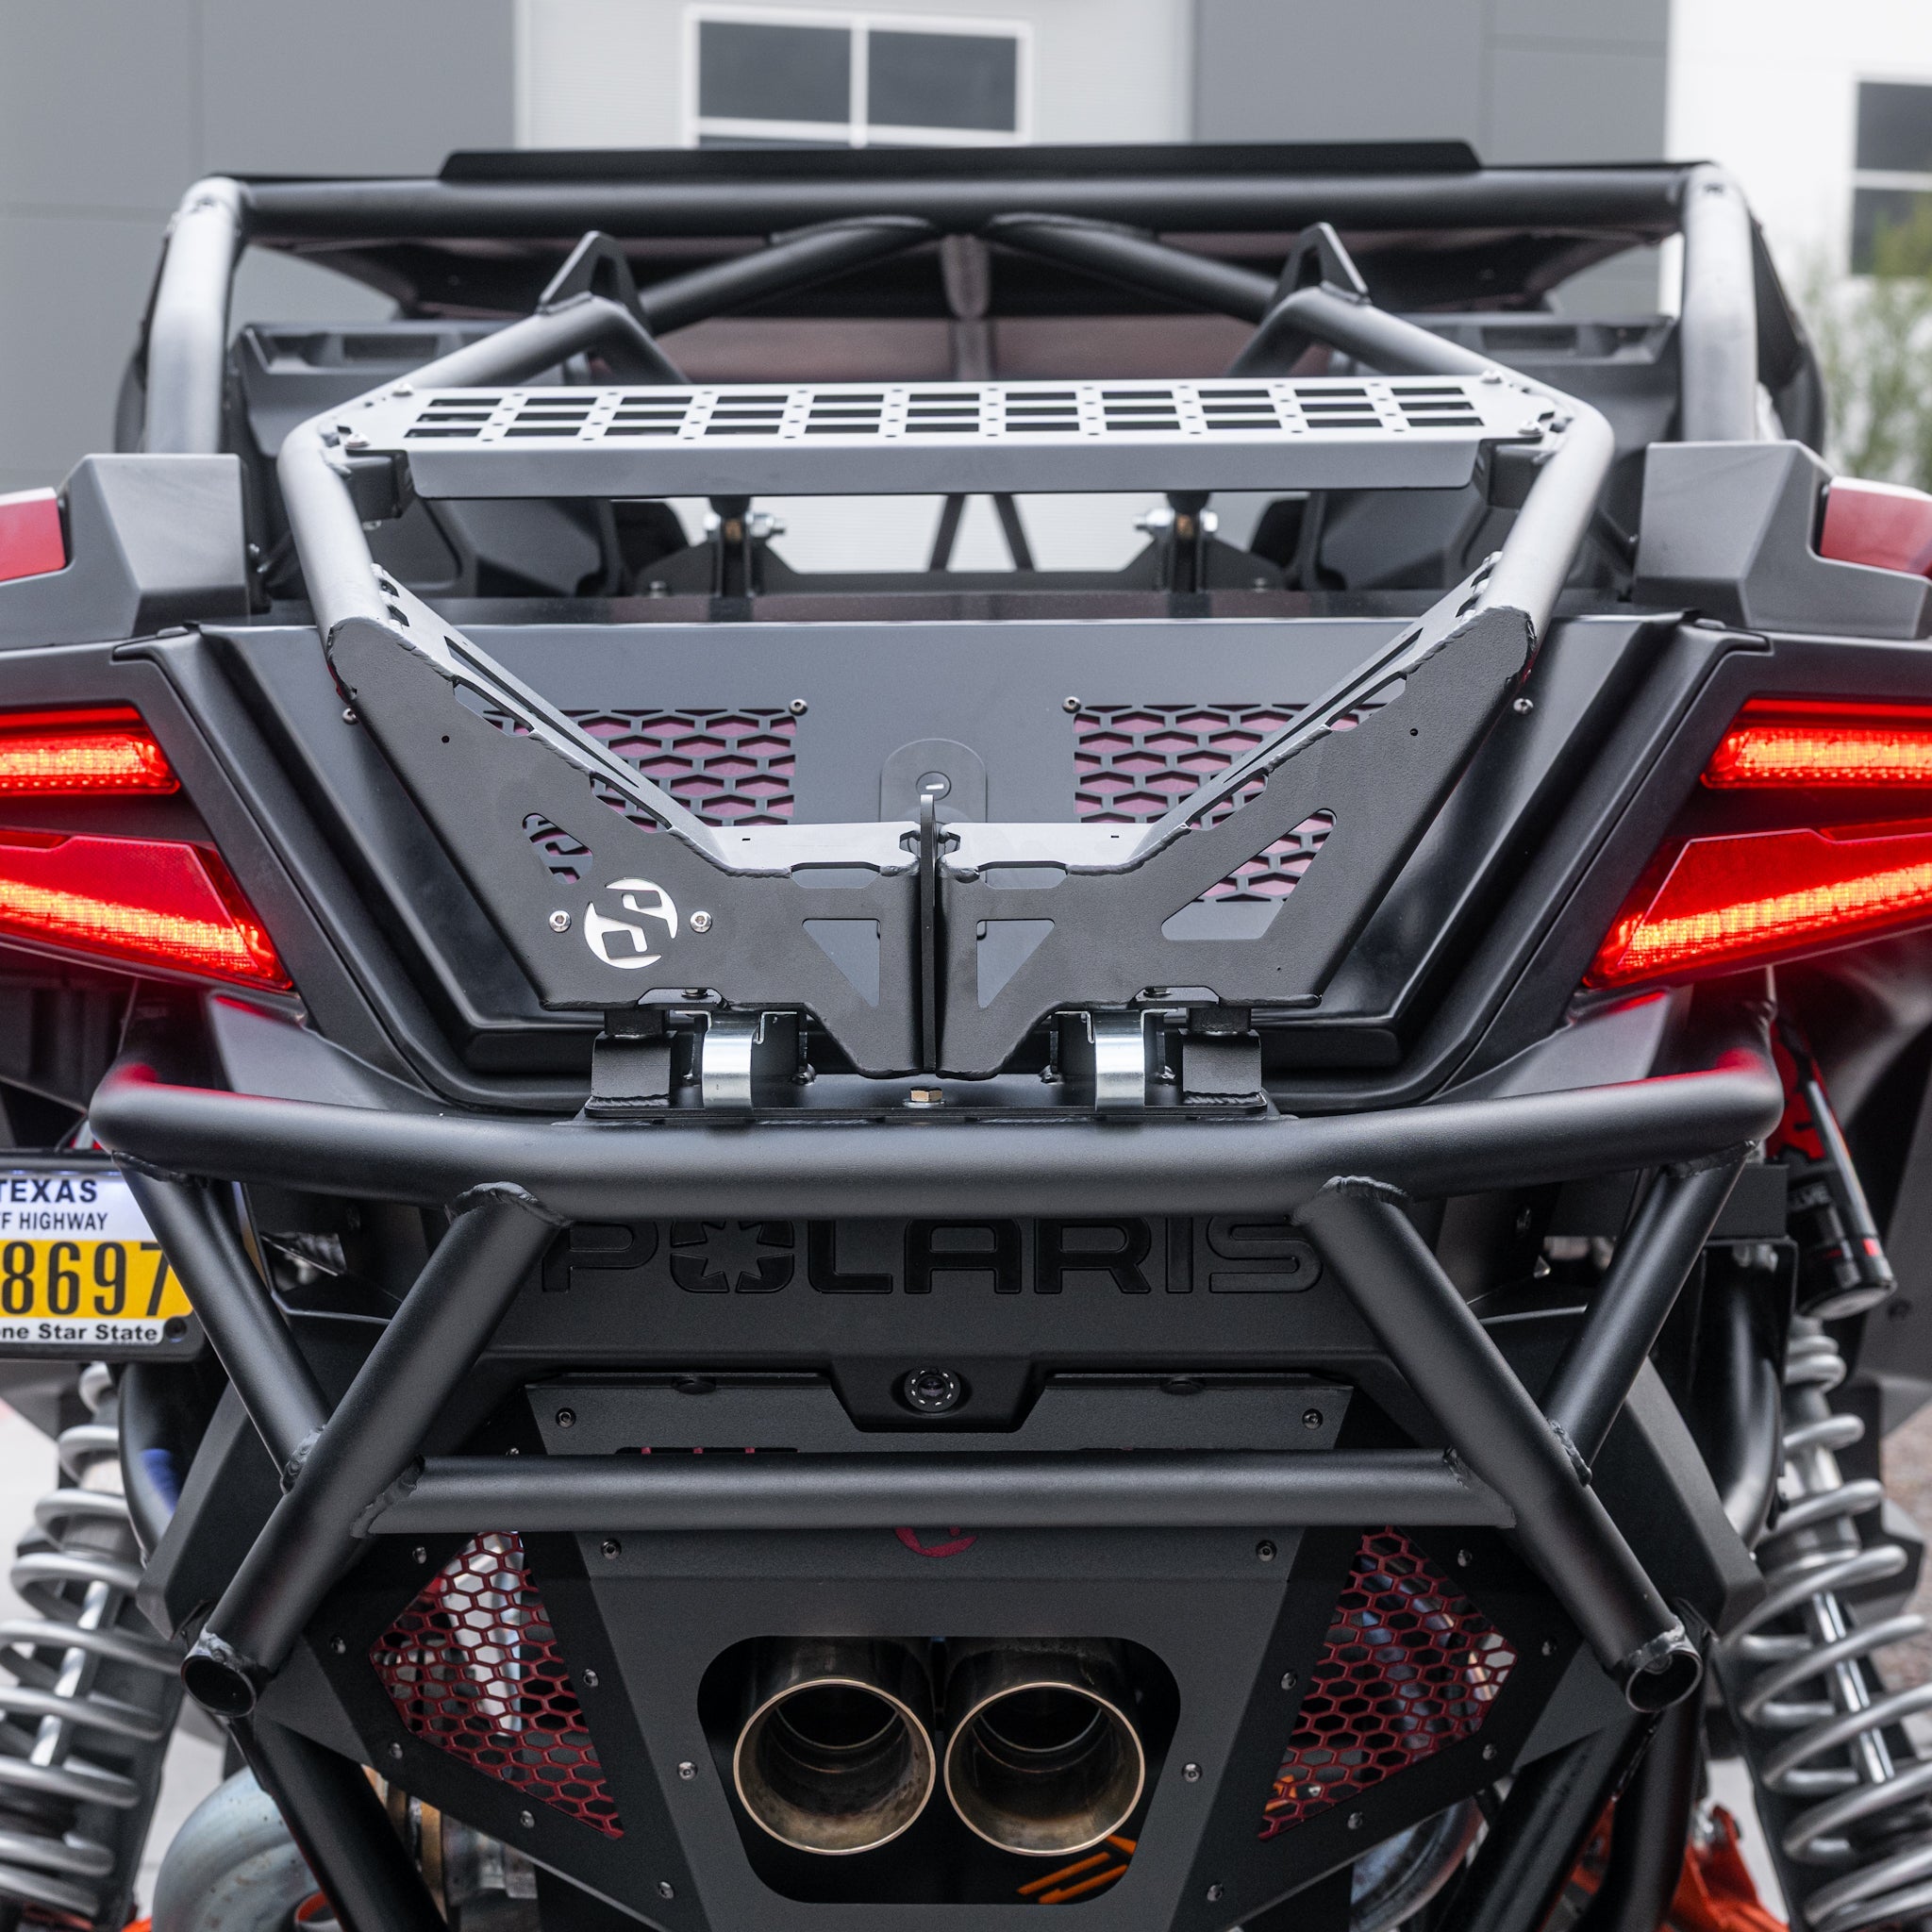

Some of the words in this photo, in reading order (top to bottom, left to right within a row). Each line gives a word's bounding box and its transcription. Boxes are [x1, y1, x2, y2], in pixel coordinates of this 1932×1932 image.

[19, 1212, 108, 1230] HIGHWAY
[2, 1241, 171, 1316] 8697
[541, 1217, 1323, 1294] POLARIS
[0, 1326, 29, 1340] ne
[39, 1323, 87, 1340] Star
[95, 1324, 158, 1341] State
